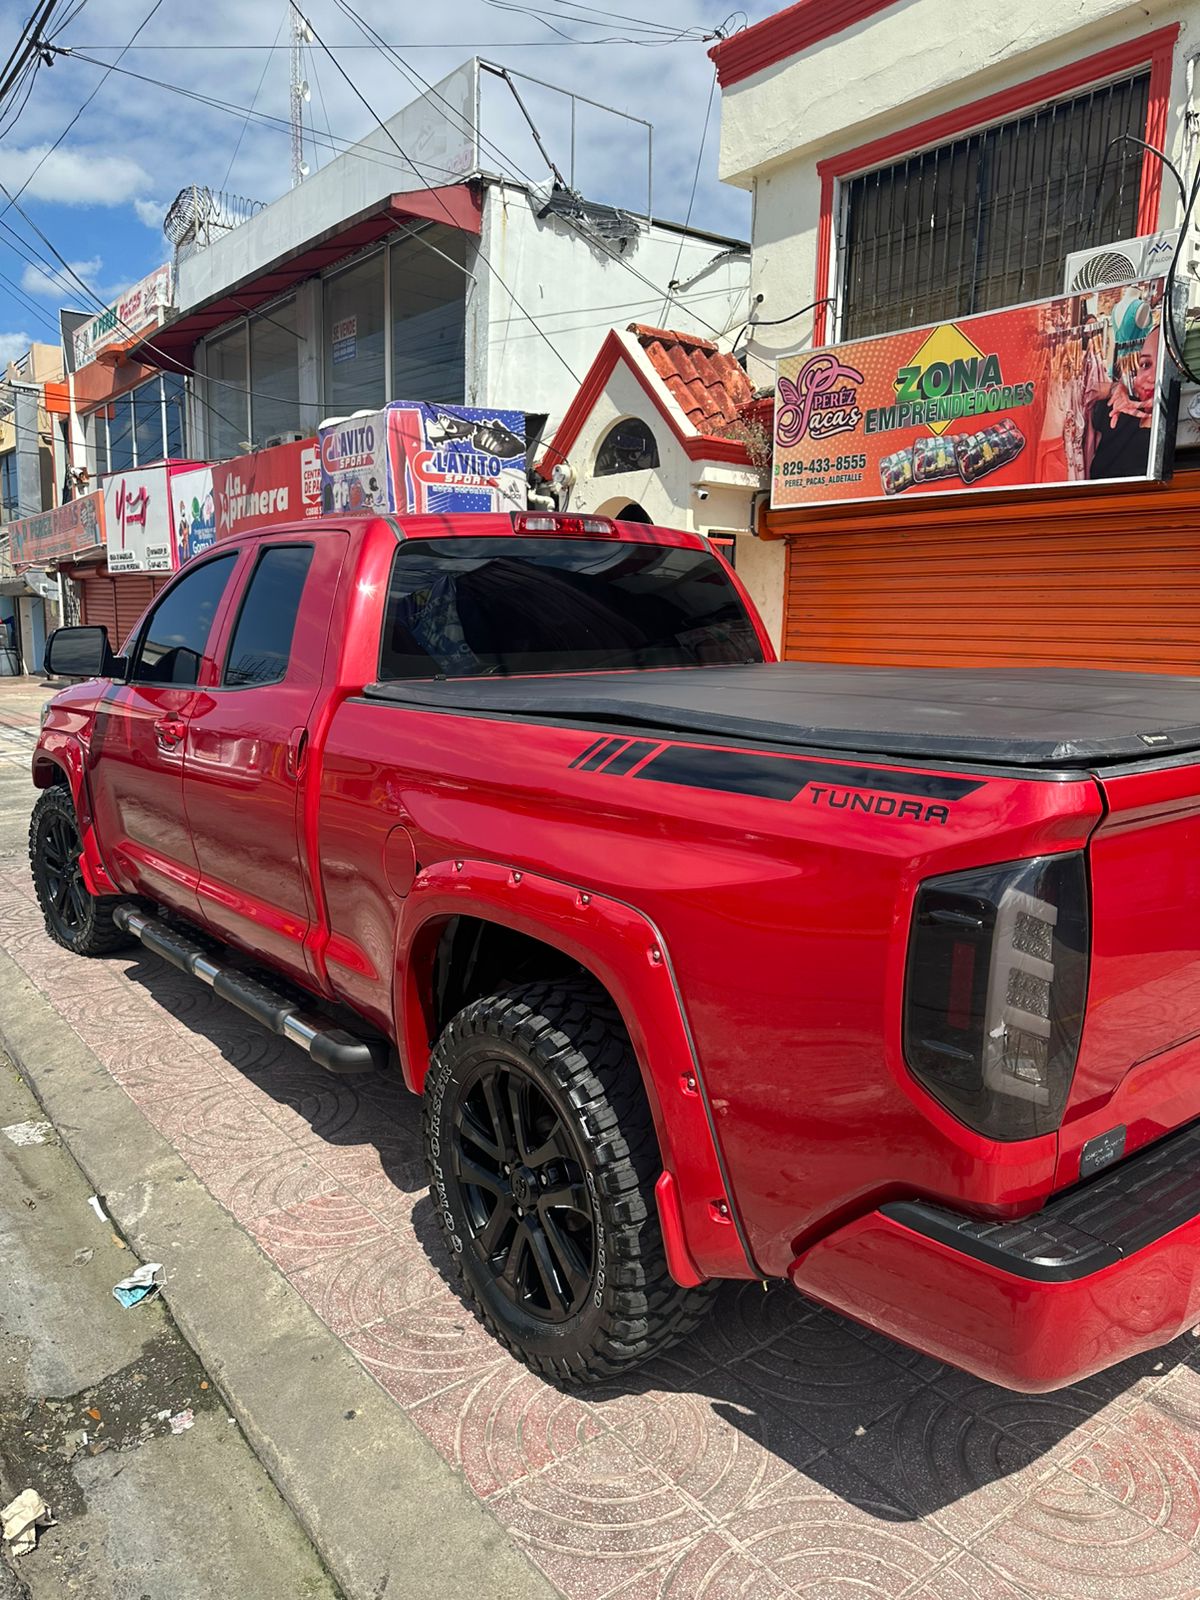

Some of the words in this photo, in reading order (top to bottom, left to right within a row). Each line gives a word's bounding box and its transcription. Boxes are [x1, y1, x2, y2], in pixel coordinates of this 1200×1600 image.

[896, 353, 1003, 404] ZONA
[864, 382, 1035, 435] EMPRENDEDORES
[304, 469, 321, 480] CENTR
[444, 474, 490, 485] SPORT
[782, 454, 867, 476] 829-433-8555
[229, 473, 241, 497] La
[230, 484, 289, 528] primera
[809, 786, 950, 824] TUNDRA
